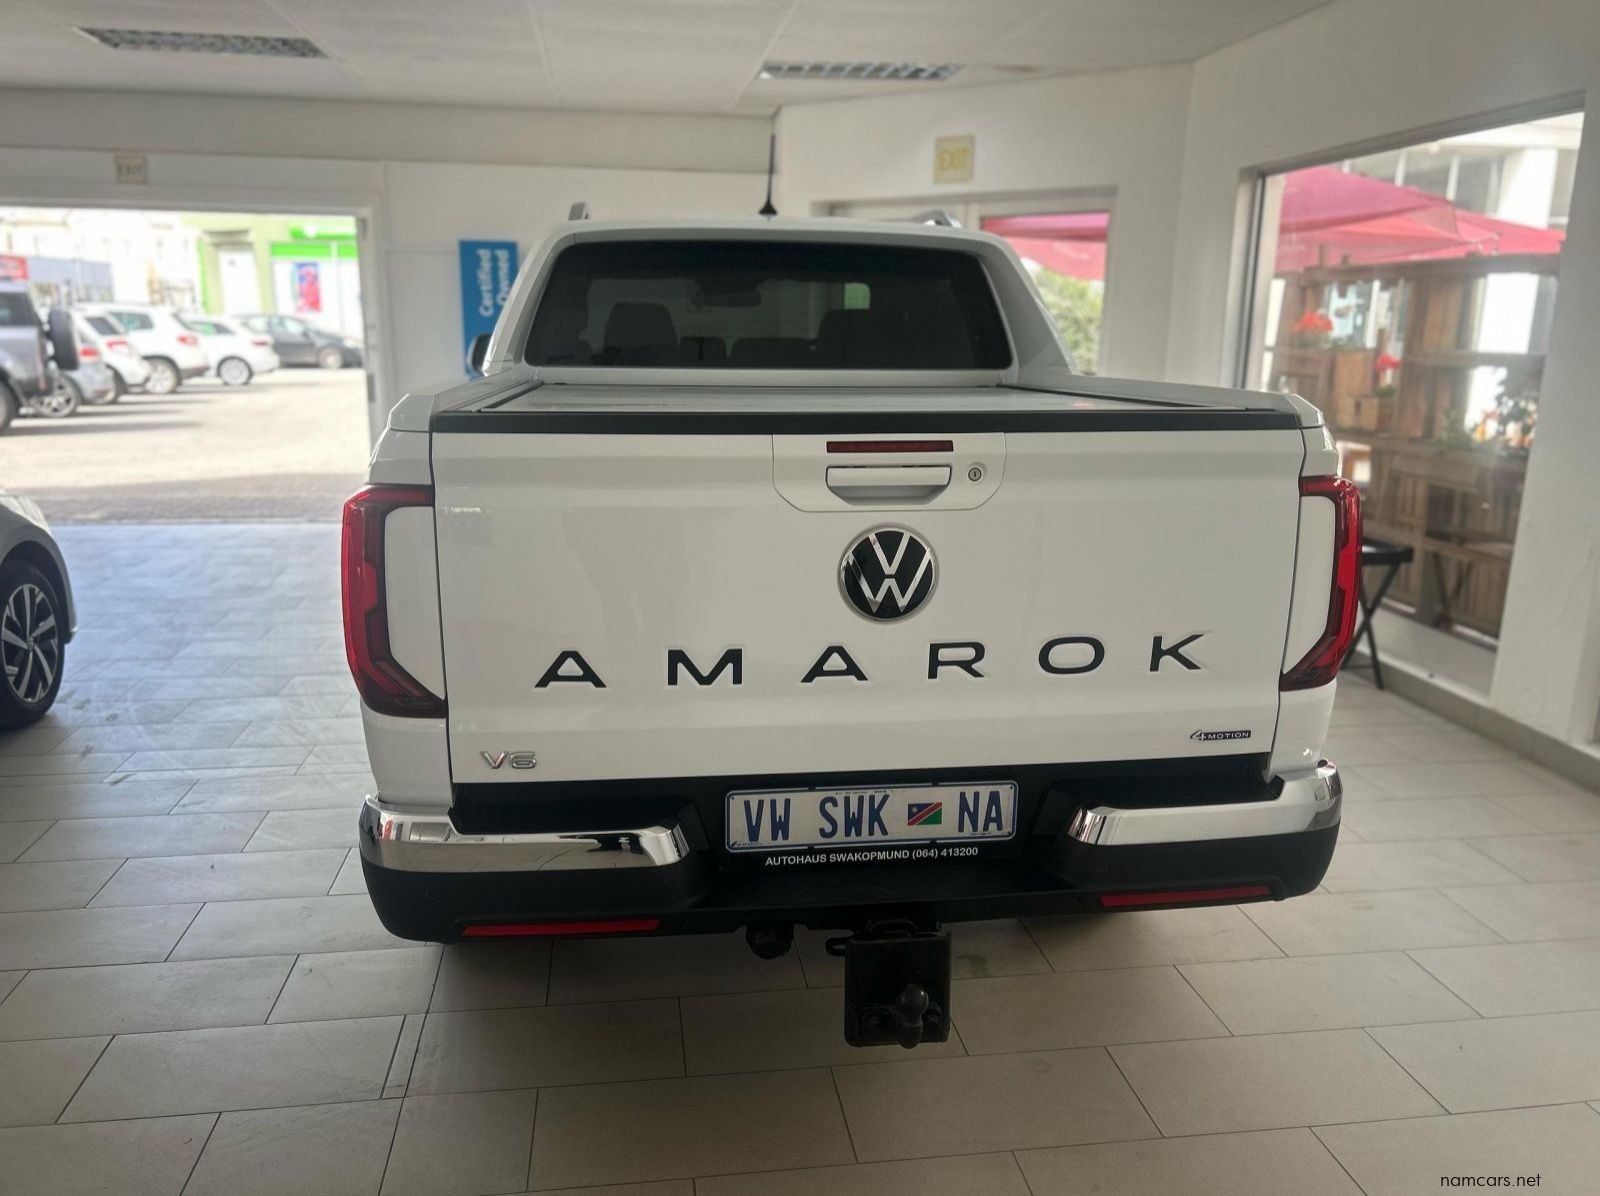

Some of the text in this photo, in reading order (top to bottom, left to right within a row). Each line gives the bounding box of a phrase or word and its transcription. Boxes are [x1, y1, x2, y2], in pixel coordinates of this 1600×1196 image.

[534, 633, 1206, 689] AMAROK
[480, 750, 537, 769] V6
[743, 790, 1003, 842] VW SWK NA
[765, 846, 978, 866] AUTOHAUS SWAKOPMUND (064) 413200
